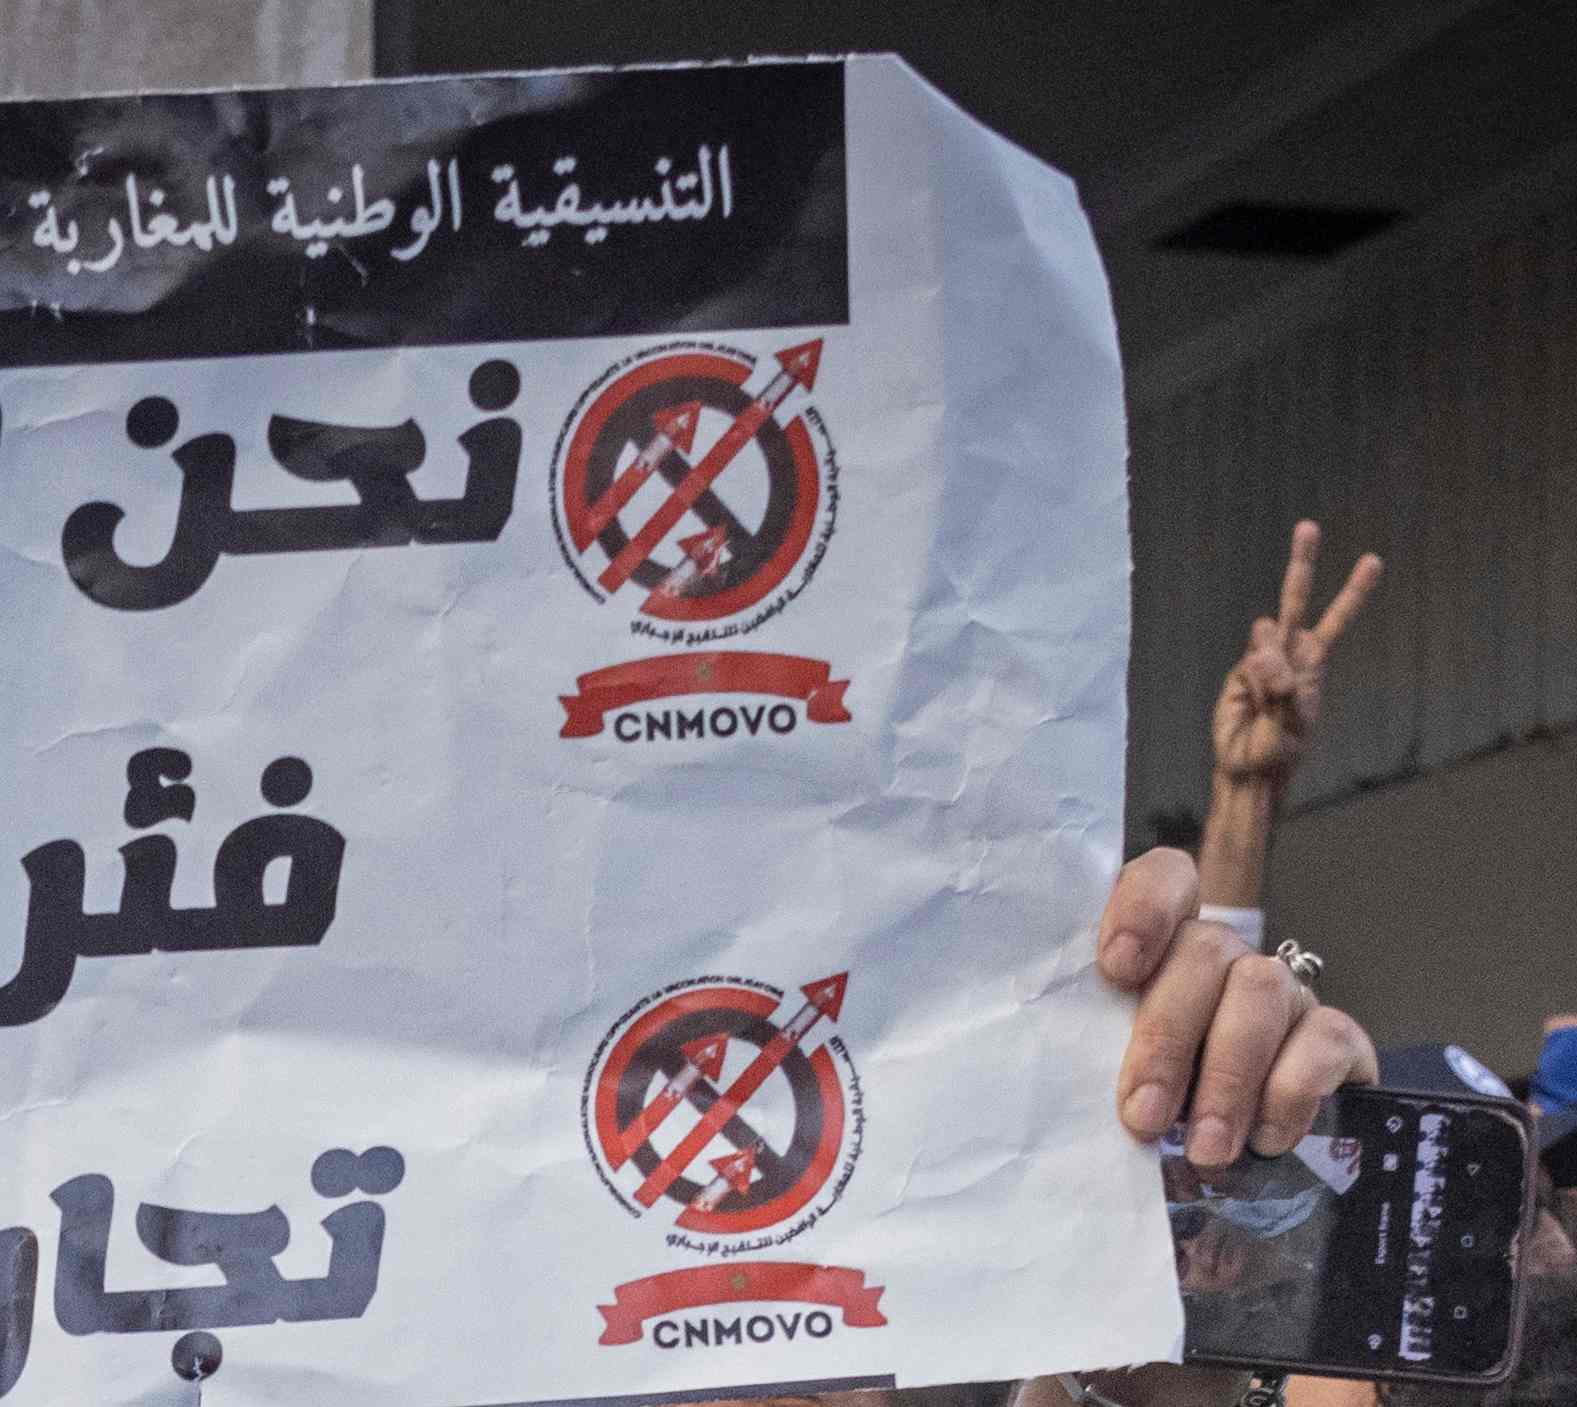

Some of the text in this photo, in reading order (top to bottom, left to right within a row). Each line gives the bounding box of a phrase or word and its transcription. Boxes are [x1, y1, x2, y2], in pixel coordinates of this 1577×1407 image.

[28, 173, 241, 276] للمغاربة
[264, 155, 464, 261] الوطنية
[491, 143, 734, 248] التنسيقية
[59, 358, 524, 613] نحن
[614, 703, 798, 743] CNMOVO
[652, 1311, 833, 1349] CNMOVO
